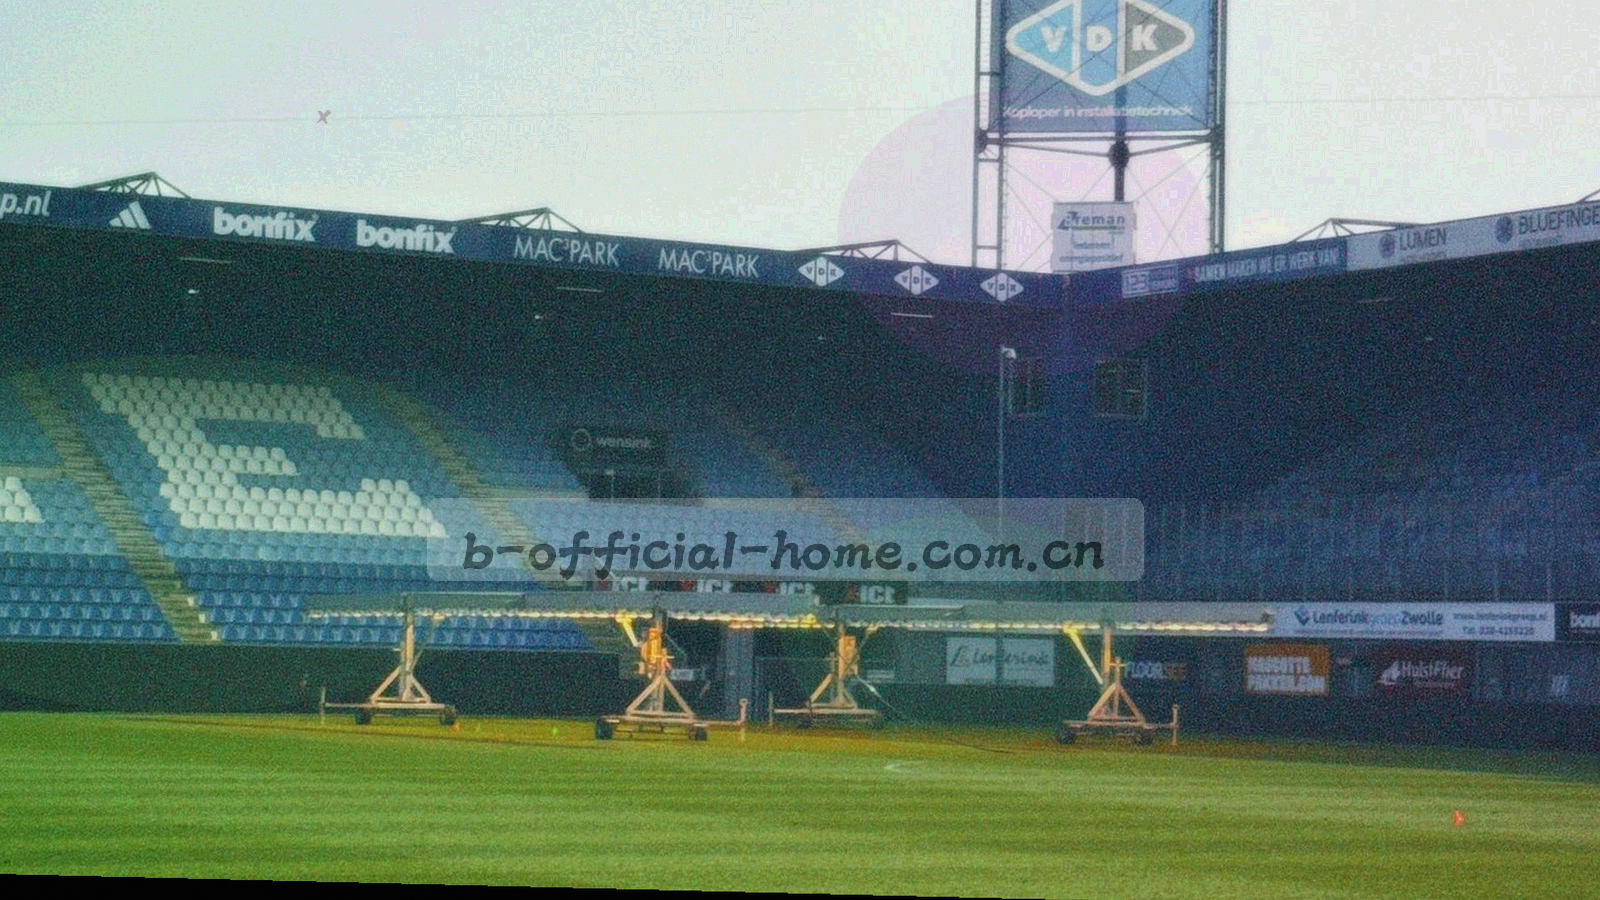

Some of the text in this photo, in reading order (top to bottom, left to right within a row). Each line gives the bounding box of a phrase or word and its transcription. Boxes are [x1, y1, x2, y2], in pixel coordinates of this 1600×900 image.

[1040, 24, 1159, 53] VDK
[1064, 106, 1075, 117] in
[213, 206, 316, 242] bonfix
[356, 219, 455, 254] bonfix
[1399, 227, 1448, 251] LUMEN
